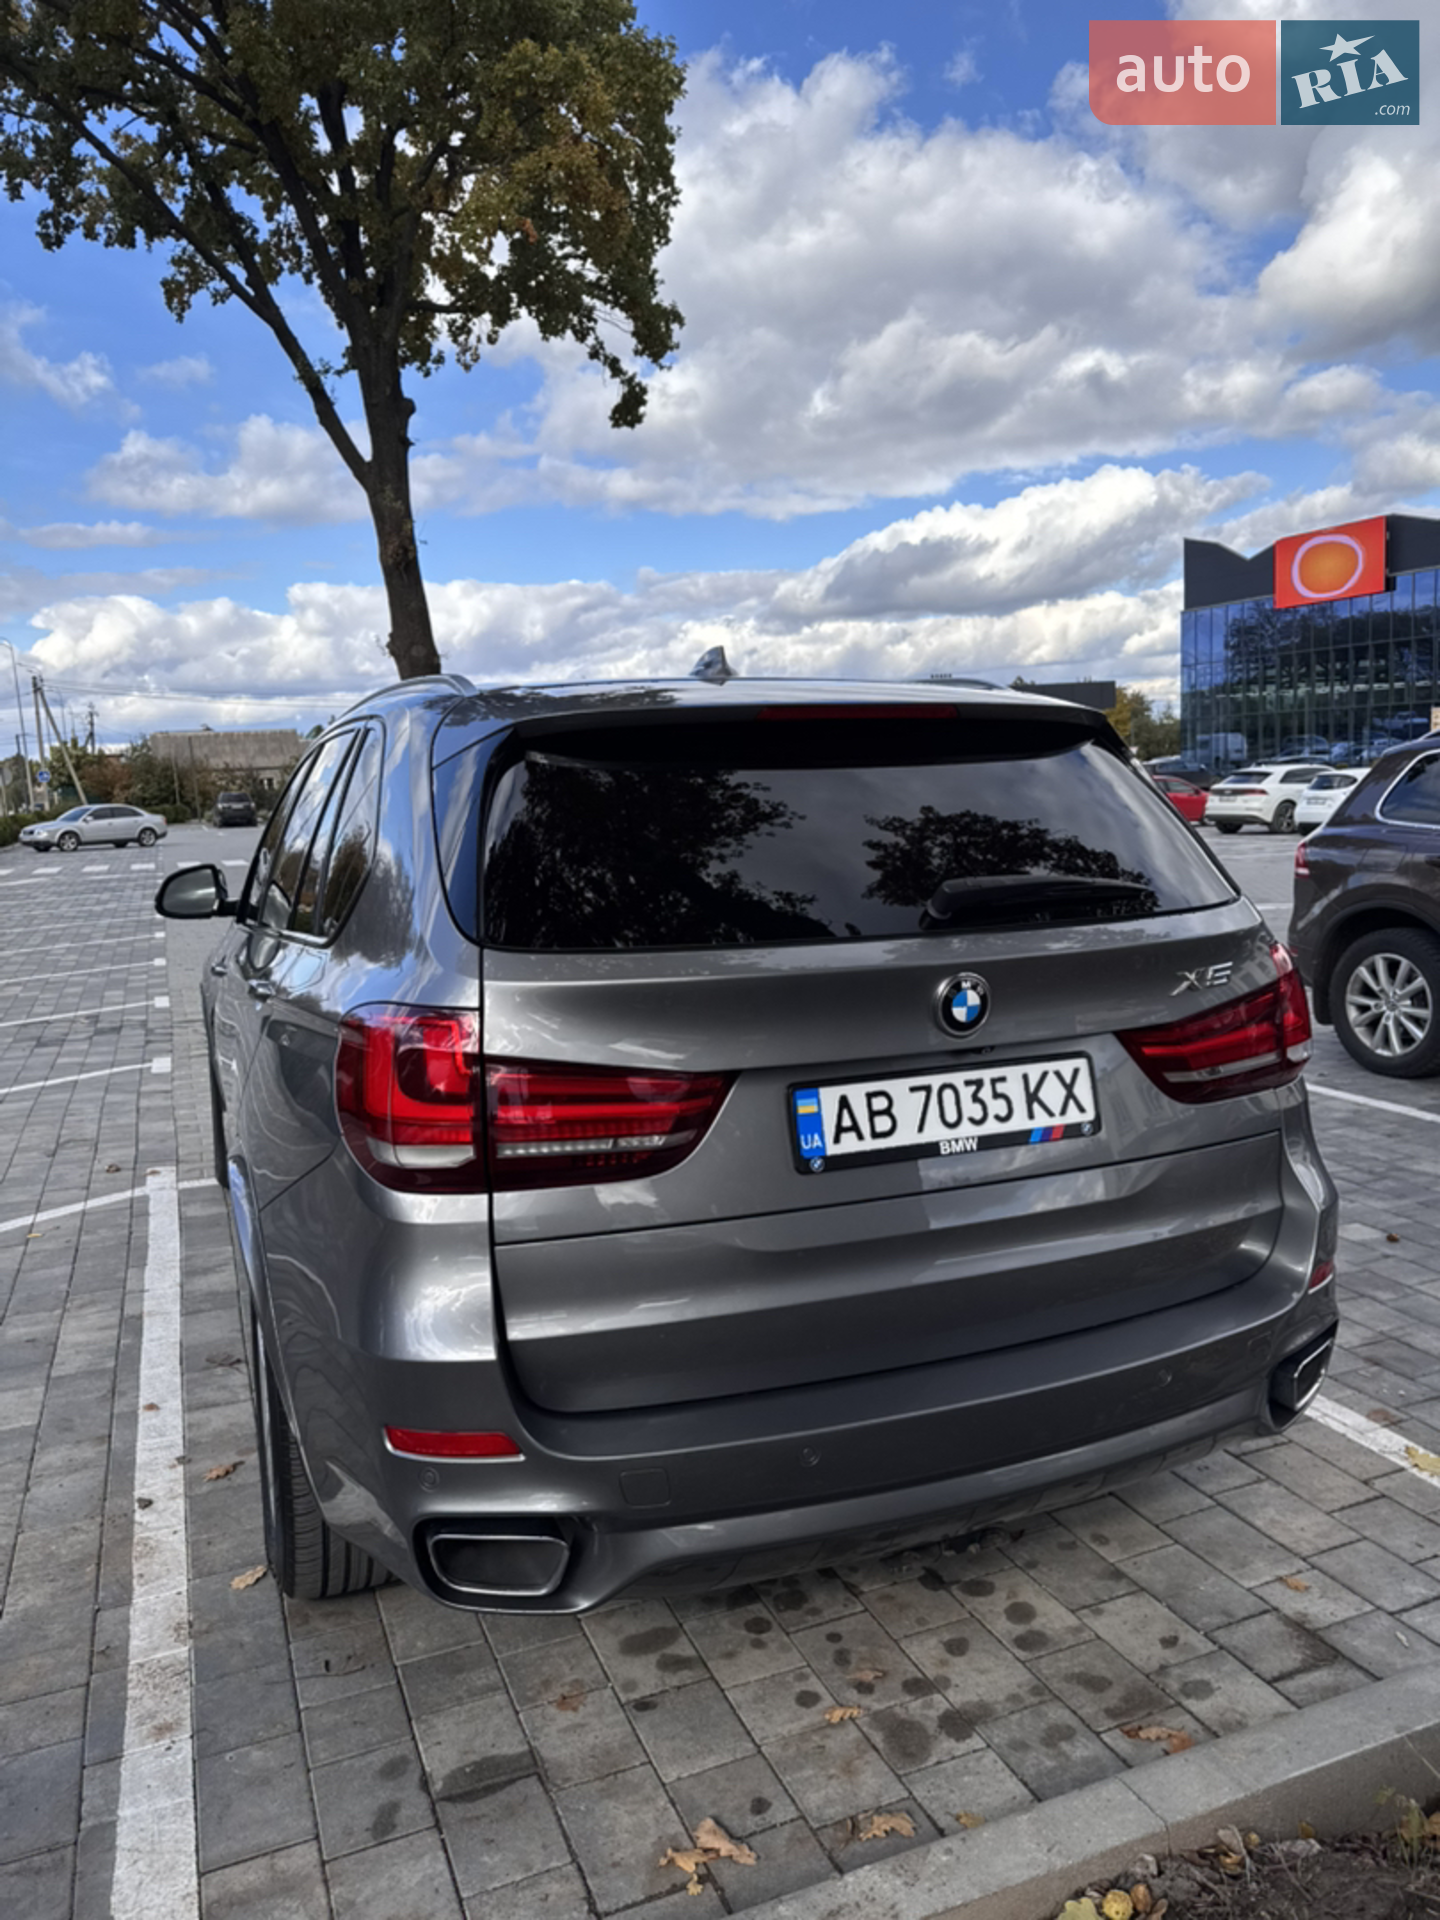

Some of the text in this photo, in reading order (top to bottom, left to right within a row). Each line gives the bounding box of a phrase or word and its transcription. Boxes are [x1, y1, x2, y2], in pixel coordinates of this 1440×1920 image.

[1170, 962, 1233, 996] X5
[833, 1067, 1087, 1145] AB 7035 KX
[801, 1133, 823, 1150] UA
[939, 1137, 979, 1156] BMW
